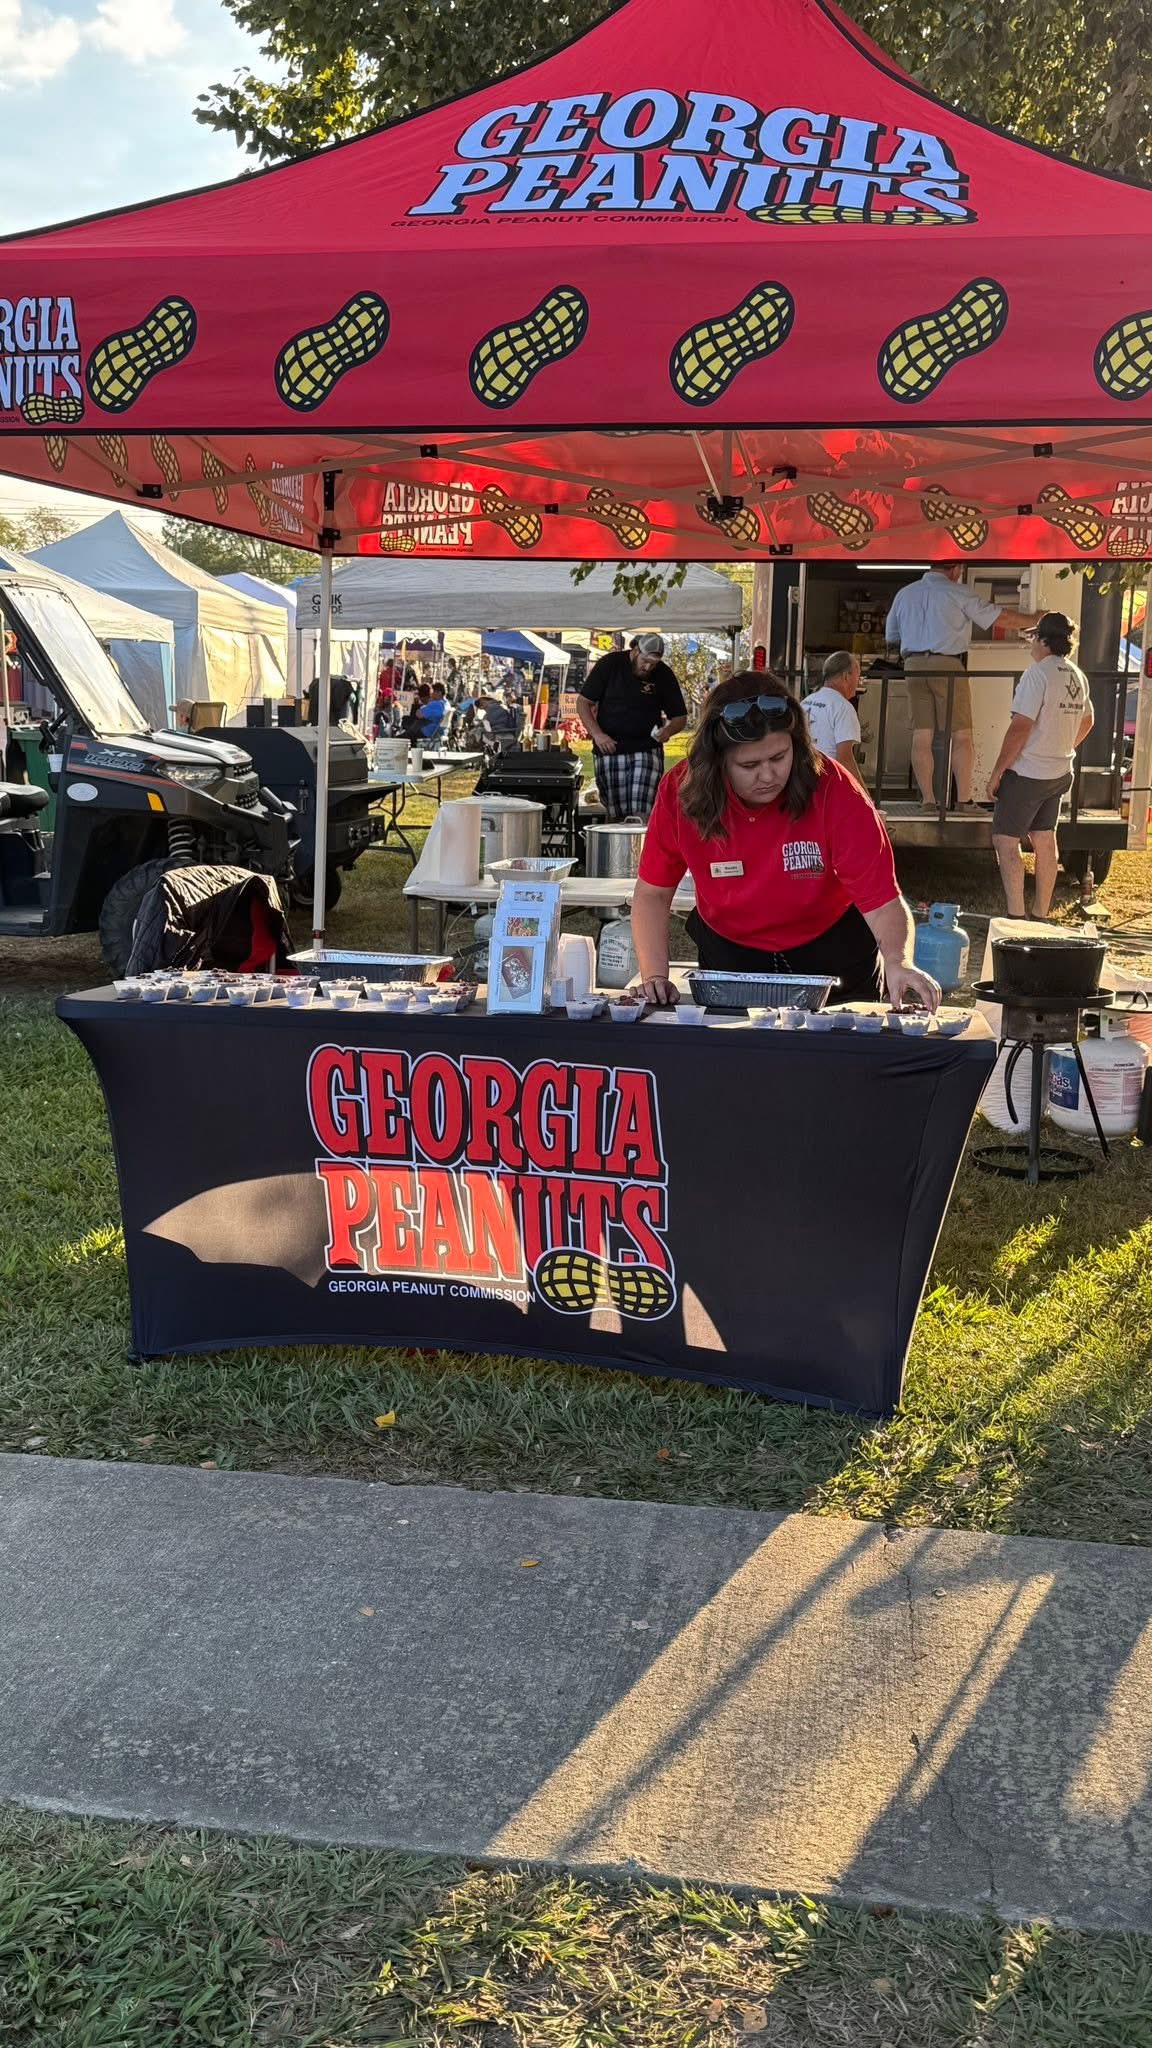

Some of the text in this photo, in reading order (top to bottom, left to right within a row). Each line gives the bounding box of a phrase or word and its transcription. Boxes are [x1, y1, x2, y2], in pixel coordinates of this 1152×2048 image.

[455, 88, 969, 181] GEORGIA
[404, 151, 975, 222] PEANUTS
[390, 214, 740, 227] GEORGIA PEANUT COMMISSION
[312, 594, 342, 605] QIK
[312, 605, 343, 614] SDE
[84, 752, 146, 773] 1000
[98, 748, 138, 758] XP
[782, 840, 821, 857] GEORGIA
[783, 854, 824, 871] PEANUTS
[306, 1043, 668, 1184] GEORGIA
[315, 1158, 674, 1283] PEANUTS
[328, 1280, 536, 1303] GEORGIA PEANUT COMMISSION
